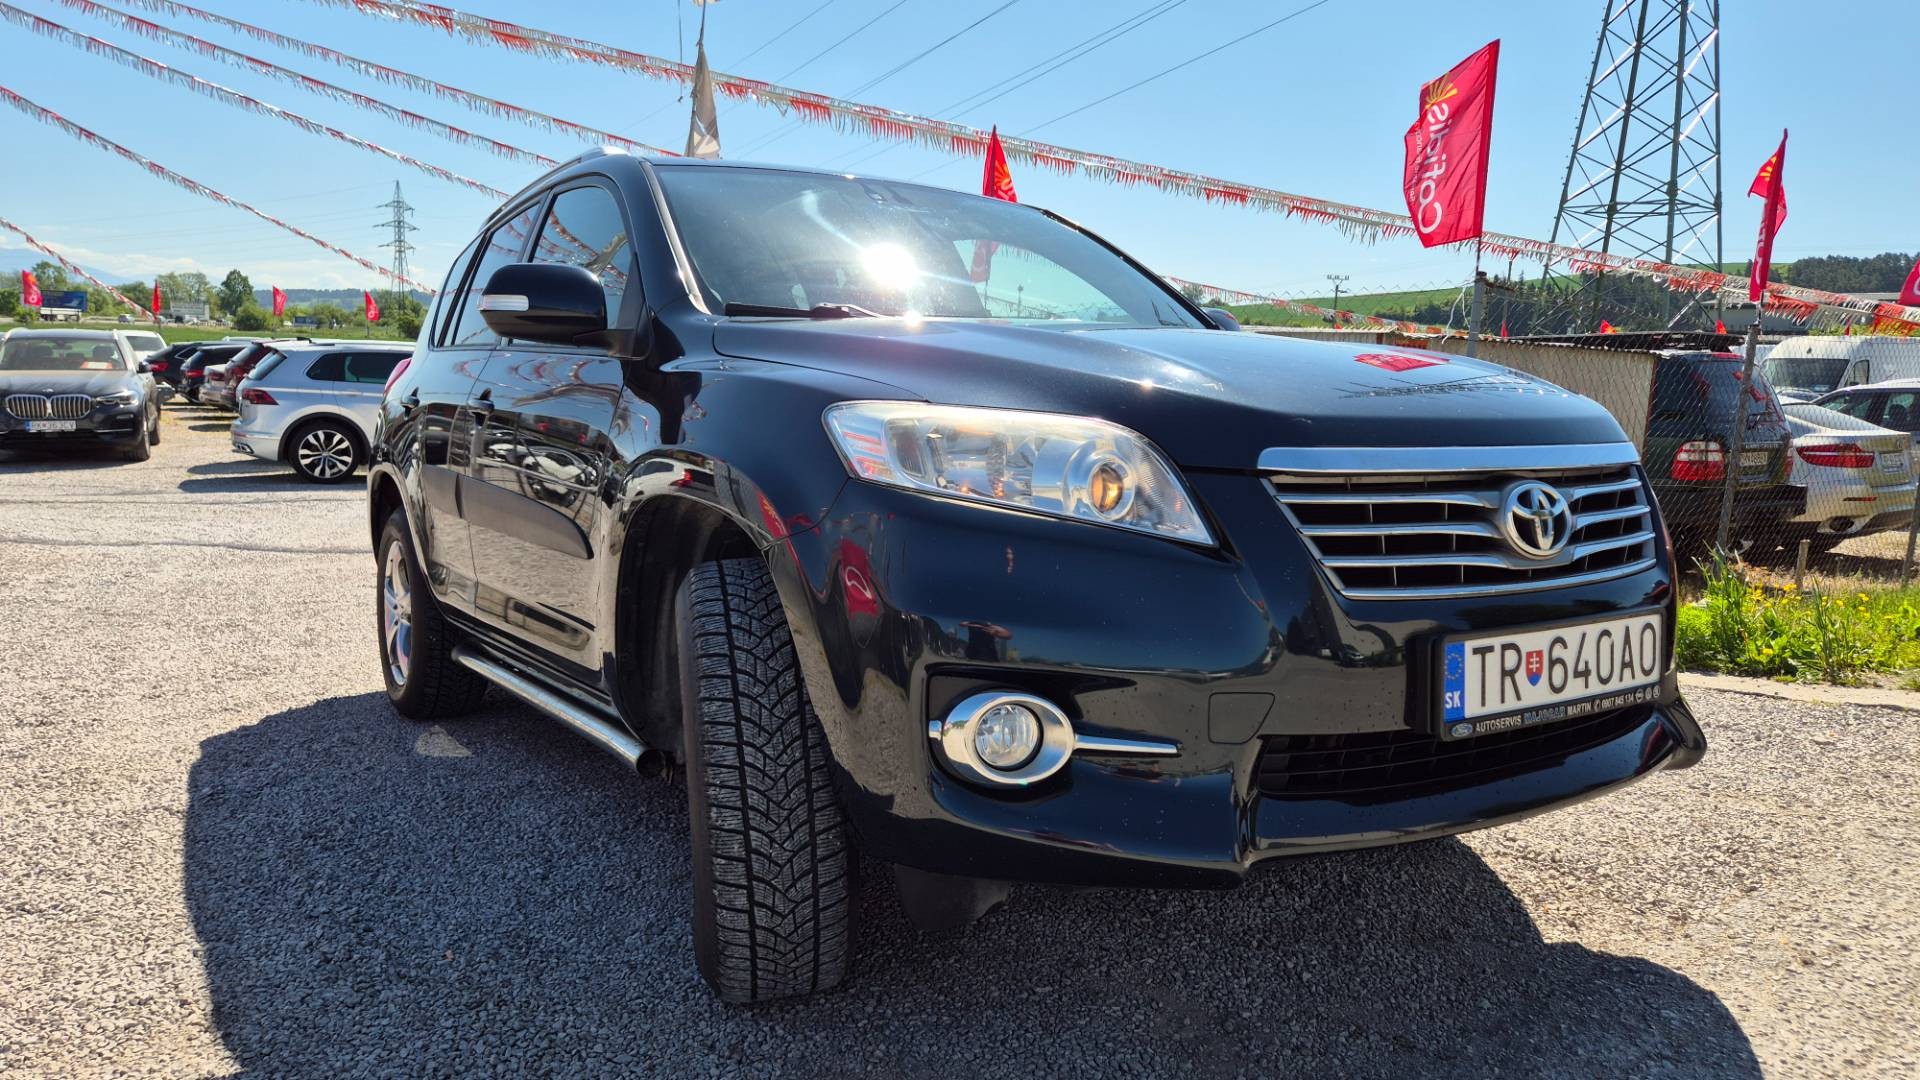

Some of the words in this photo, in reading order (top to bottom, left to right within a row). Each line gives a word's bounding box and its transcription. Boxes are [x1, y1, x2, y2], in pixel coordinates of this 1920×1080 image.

[1472, 642, 1522, 708] TR
[1548, 622, 1657, 695] 640AO
[1445, 690, 1461, 709] SK
[1475, 714, 1522, 733] AUTOSERVIS
[1567, 701, 1592, 716] MARTIN
